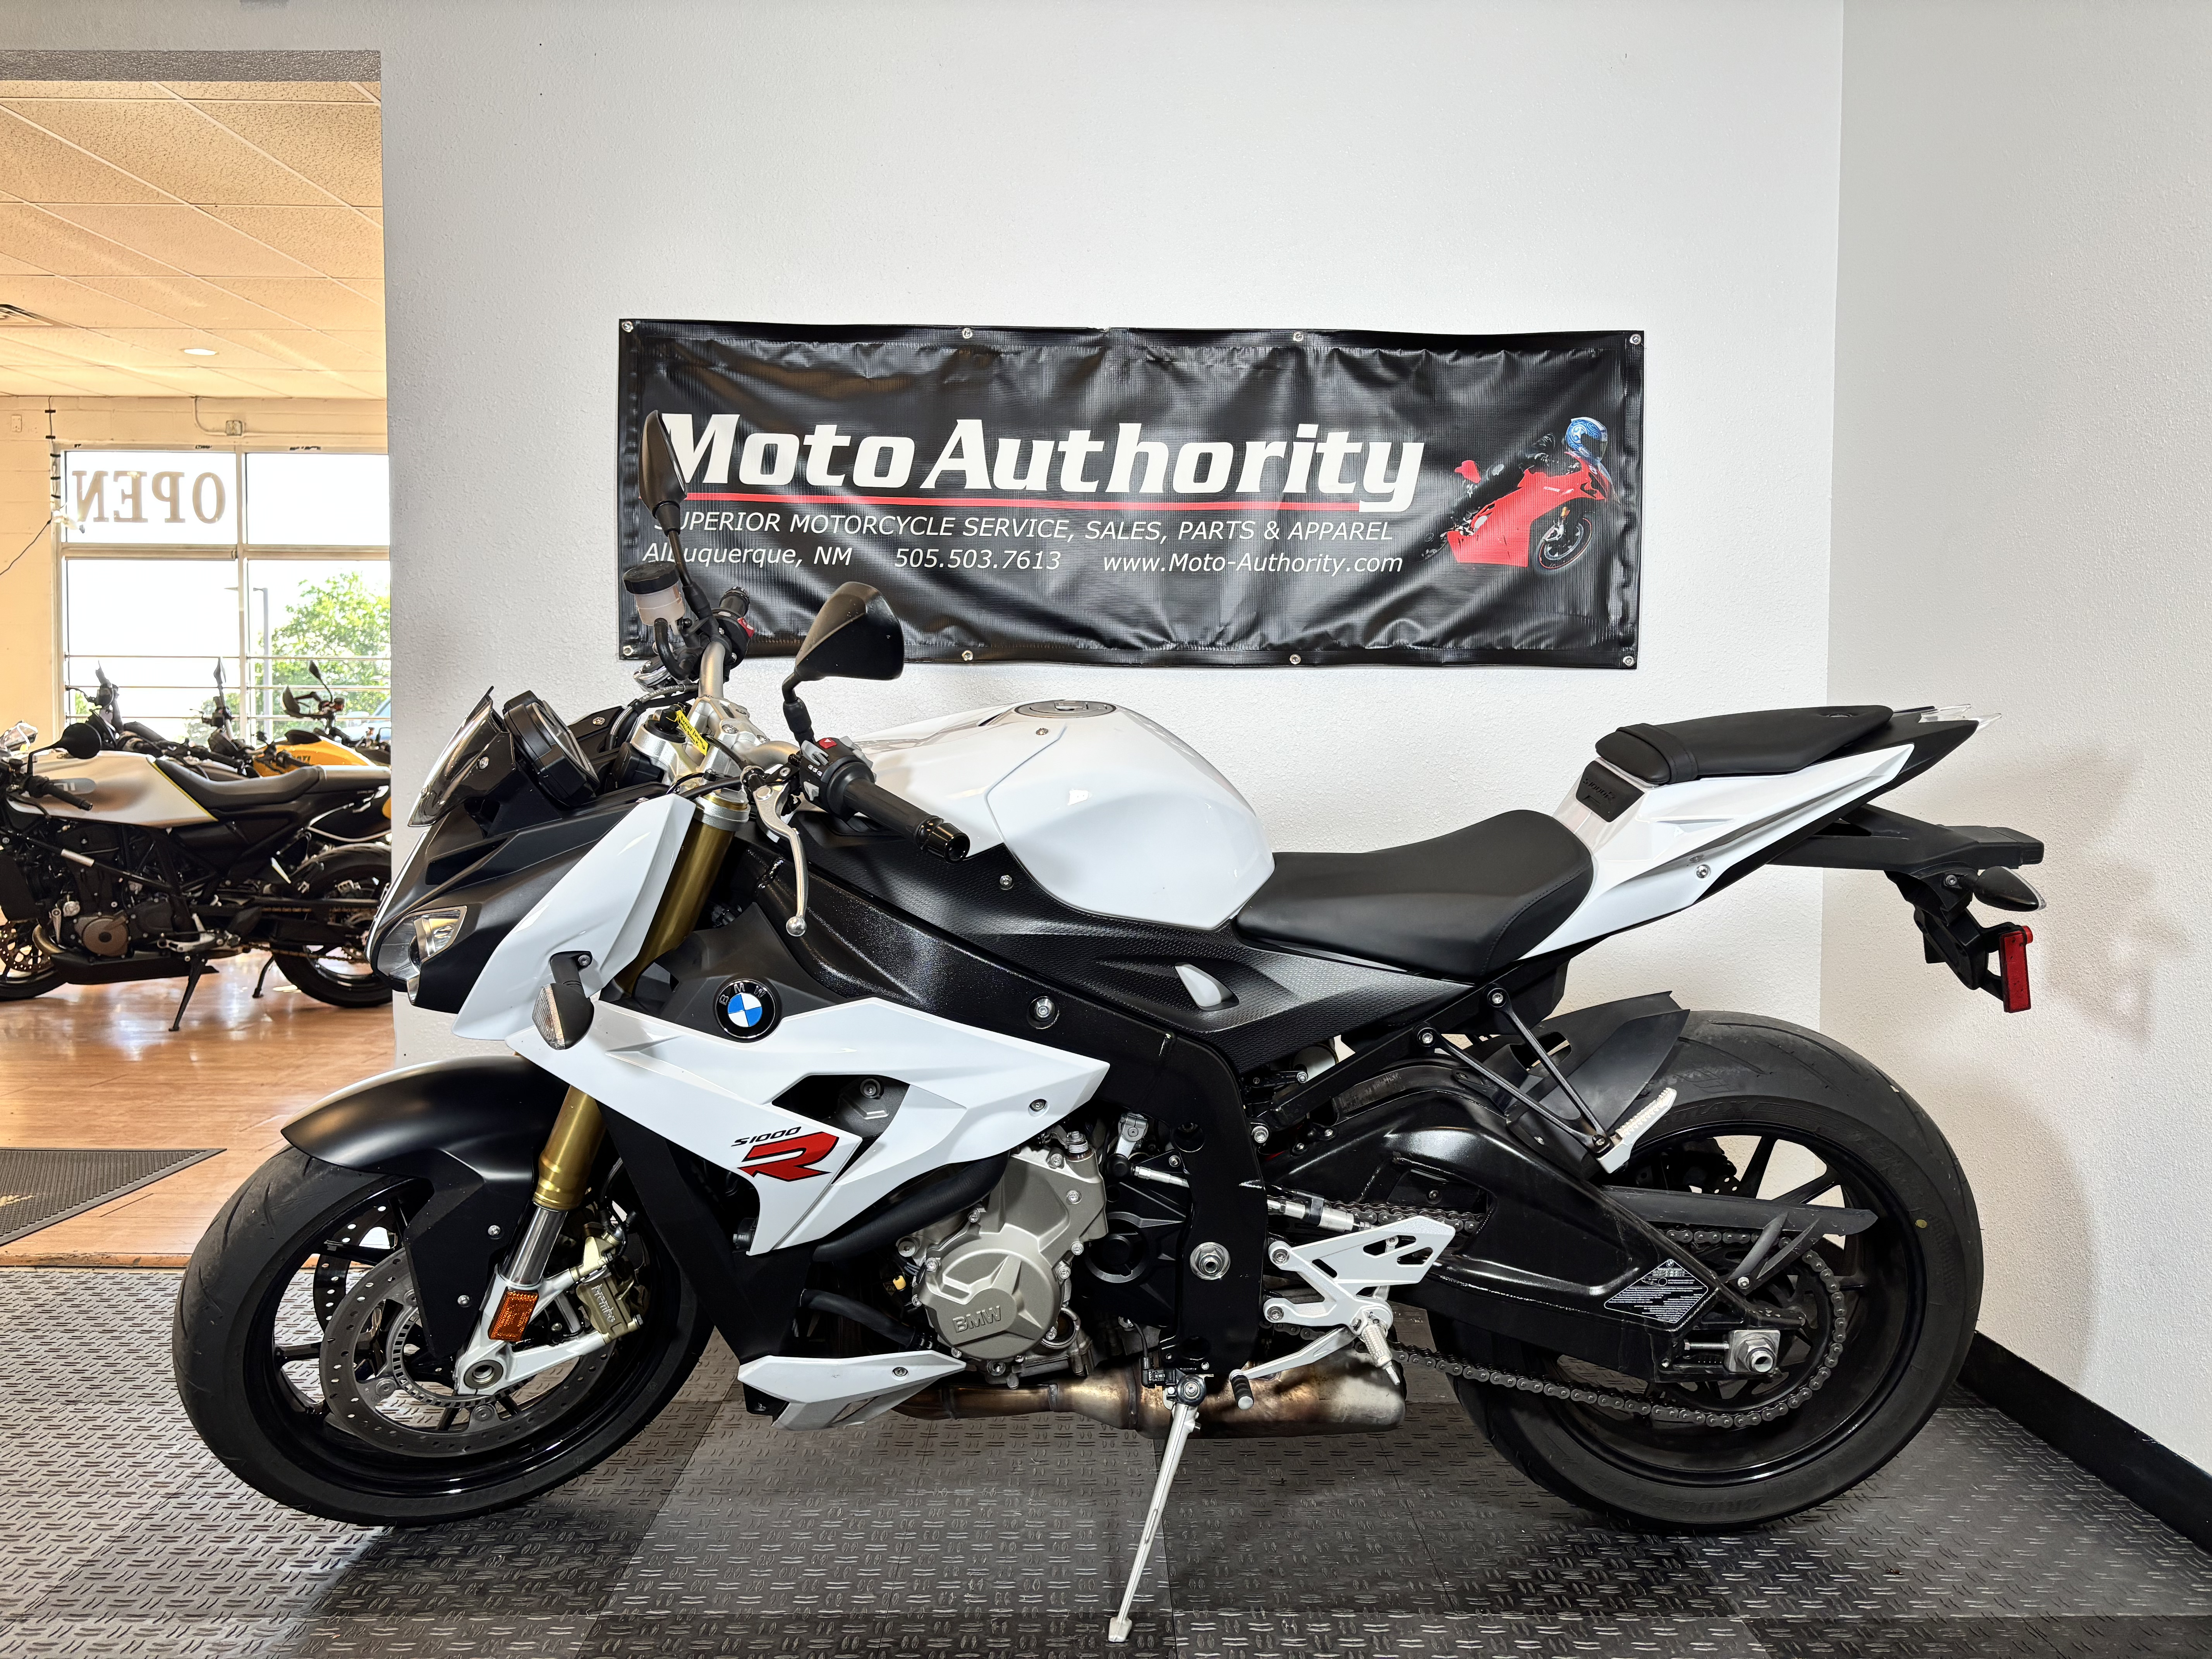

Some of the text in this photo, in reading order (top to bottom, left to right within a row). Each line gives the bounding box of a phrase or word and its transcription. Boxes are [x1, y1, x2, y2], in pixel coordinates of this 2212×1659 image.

[661, 413, 1425, 512] Moto Authority
[654, 512, 1393, 544] PERIOR MOTORCYCLE SERVICE, SALES, PARTS & APPAREL
[814, 547, 852, 566] NM
[895, 548, 1061, 570] 505.503.7613
[1104, 553, 1403, 576] www.Moto-Authority.com
[719, 984, 766, 1005] BMW
[731, 1127, 801, 1147] S1000
[737, 1132, 839, 1182] R
[591, 1284, 616, 1323] brembo
[952, 1305, 1002, 1333] BMW
